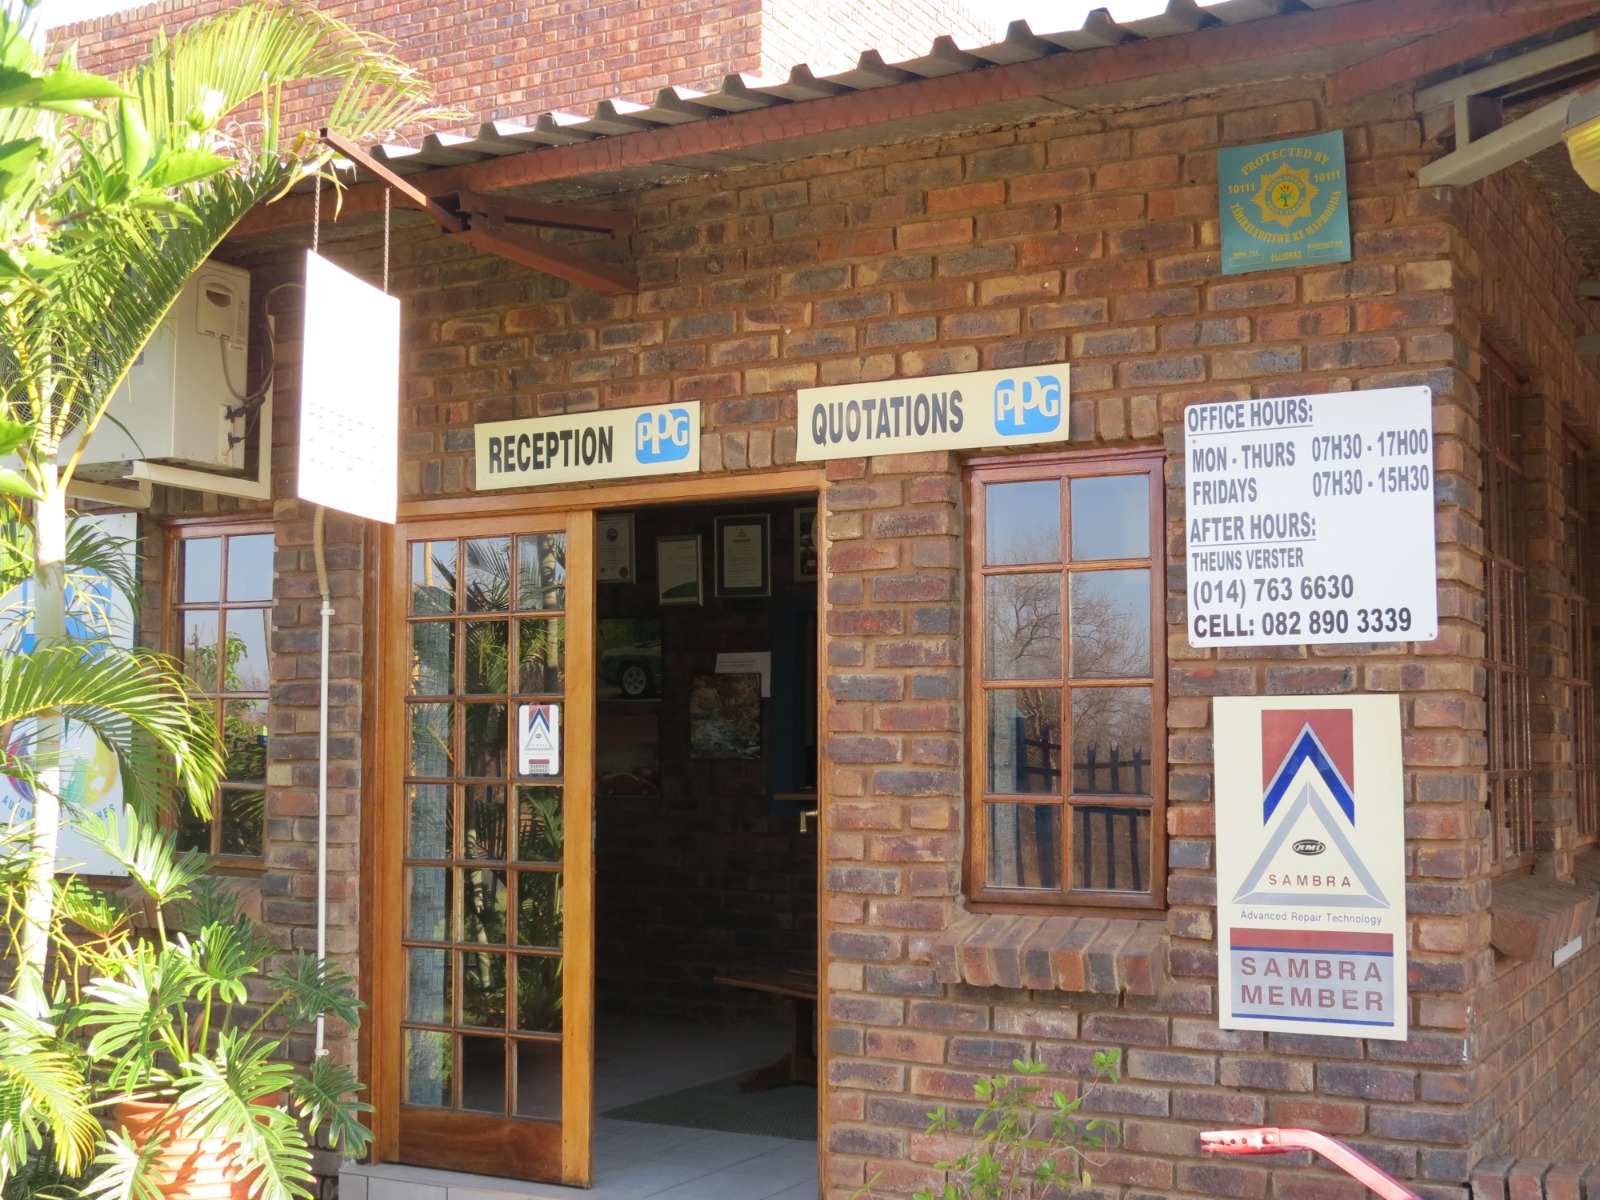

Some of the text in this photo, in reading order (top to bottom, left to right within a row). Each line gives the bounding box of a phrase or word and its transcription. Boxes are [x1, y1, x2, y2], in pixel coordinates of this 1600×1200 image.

[1241, 148, 1330, 176] PROTECTED BY
[1314, 170, 1341, 182] 10111
[1227, 182, 1255, 194] 10111
[1270, 250, 1303, 262] ELLISRAS
[811, 376, 1061, 446] QUOTATIONS PPG
[1188, 399, 1313, 432] OFFICE HOURS:
[489, 410, 690, 474] RECEPTION PPG
[1312, 433, 1362, 462] 07H30
[1377, 428, 1428, 457] 17H00
[1192, 446, 1227, 473] MON
[1241, 441, 1296, 469] THURS
[1193, 477, 1258, 505] FRIDAYS
[1313, 469, 1363, 497] 07H30
[1378, 464, 1429, 493] 15H30
[1190, 511, 1316, 543] AFTER HOURS:
[1192, 547, 1304, 572] THEUNS VERSTER
[1193, 574, 1354, 610] (014) 763 6630
[1194, 607, 1412, 638] CELL: 082 890 3339
[1269, 875, 1351, 887] SAMBRA
[1240, 910, 1382, 926] Advanced Repair Technology
[1240, 956, 1383, 983] SAMBRA
[1240, 984, 1384, 1012] MEMBER
